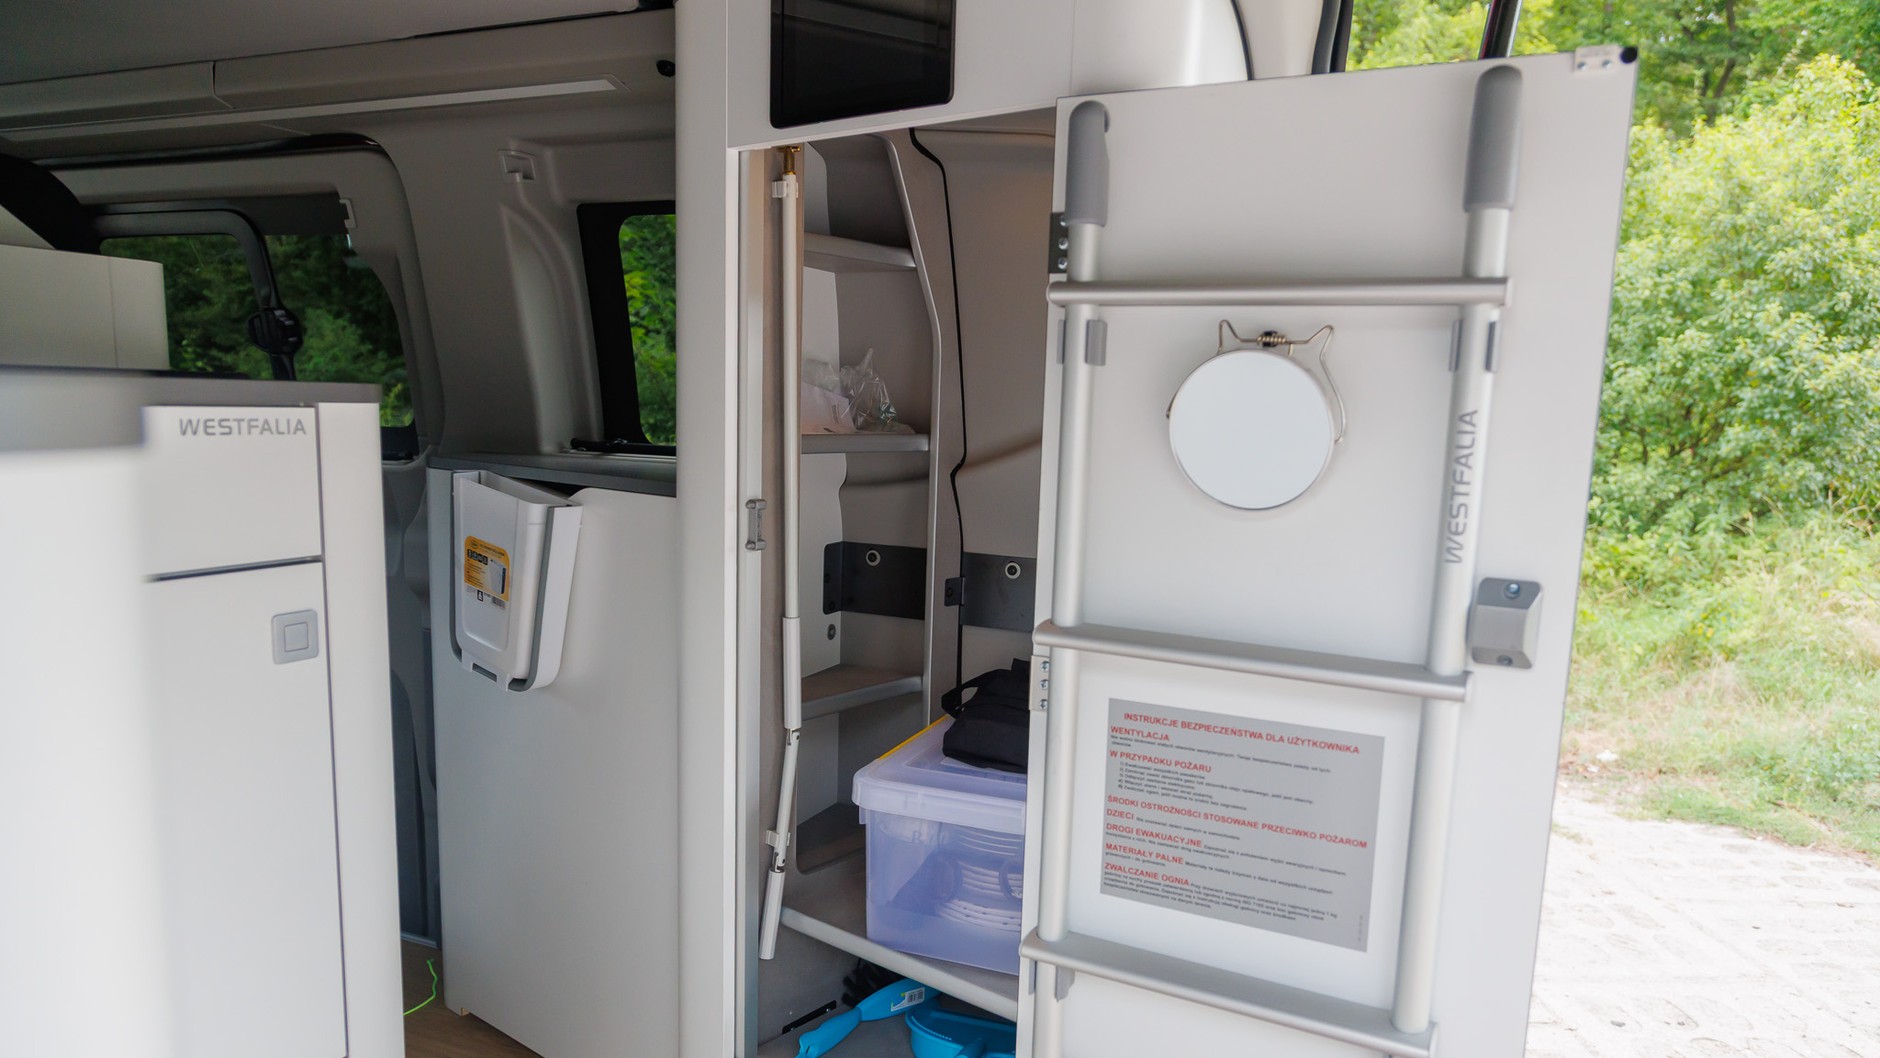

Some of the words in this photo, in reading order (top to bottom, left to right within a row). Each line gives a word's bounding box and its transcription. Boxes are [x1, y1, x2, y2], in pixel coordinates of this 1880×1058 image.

[179, 418, 307, 436] WESTFALIA
[1445, 409, 1479, 564] WESTFALIA
[1110, 726, 1170, 742] WENTYLACJA
[1124, 713, 1179, 728] INSTRUKCJE
[1181, 720, 1264, 740] BEZPIECZEŃSTWA
[1265, 732, 1285, 743] DLA
[1287, 735, 1360, 754] UŻYTKOWNIKA
[1109, 750, 1118, 758] W
[1119, 751, 1173, 767] PRZYPADKU
[1174, 759, 1212, 773] POŻARU
[1106, 809, 1134, 820] DZIECI
[1107, 795, 1139, 808] ŚRODKI
[1140, 801, 1201, 820] OSTROŻNOŚCI
[1203, 812, 1259, 829] STOSOWANE
[1261, 822, 1317, 840] PRZECIWKO
[1319, 832, 1368, 849] POŻAROM
[1106, 823, 1134, 835] DROGI
[1135, 828, 1202, 848] EWAKUACYJNE
[1105, 843, 1153, 860] MATERIAŁY
[1155, 852, 1184, 865] PALNE
[1104, 862, 1159, 882] ZWALCZANIE
[1161, 874, 1190, 887] OGNIA
